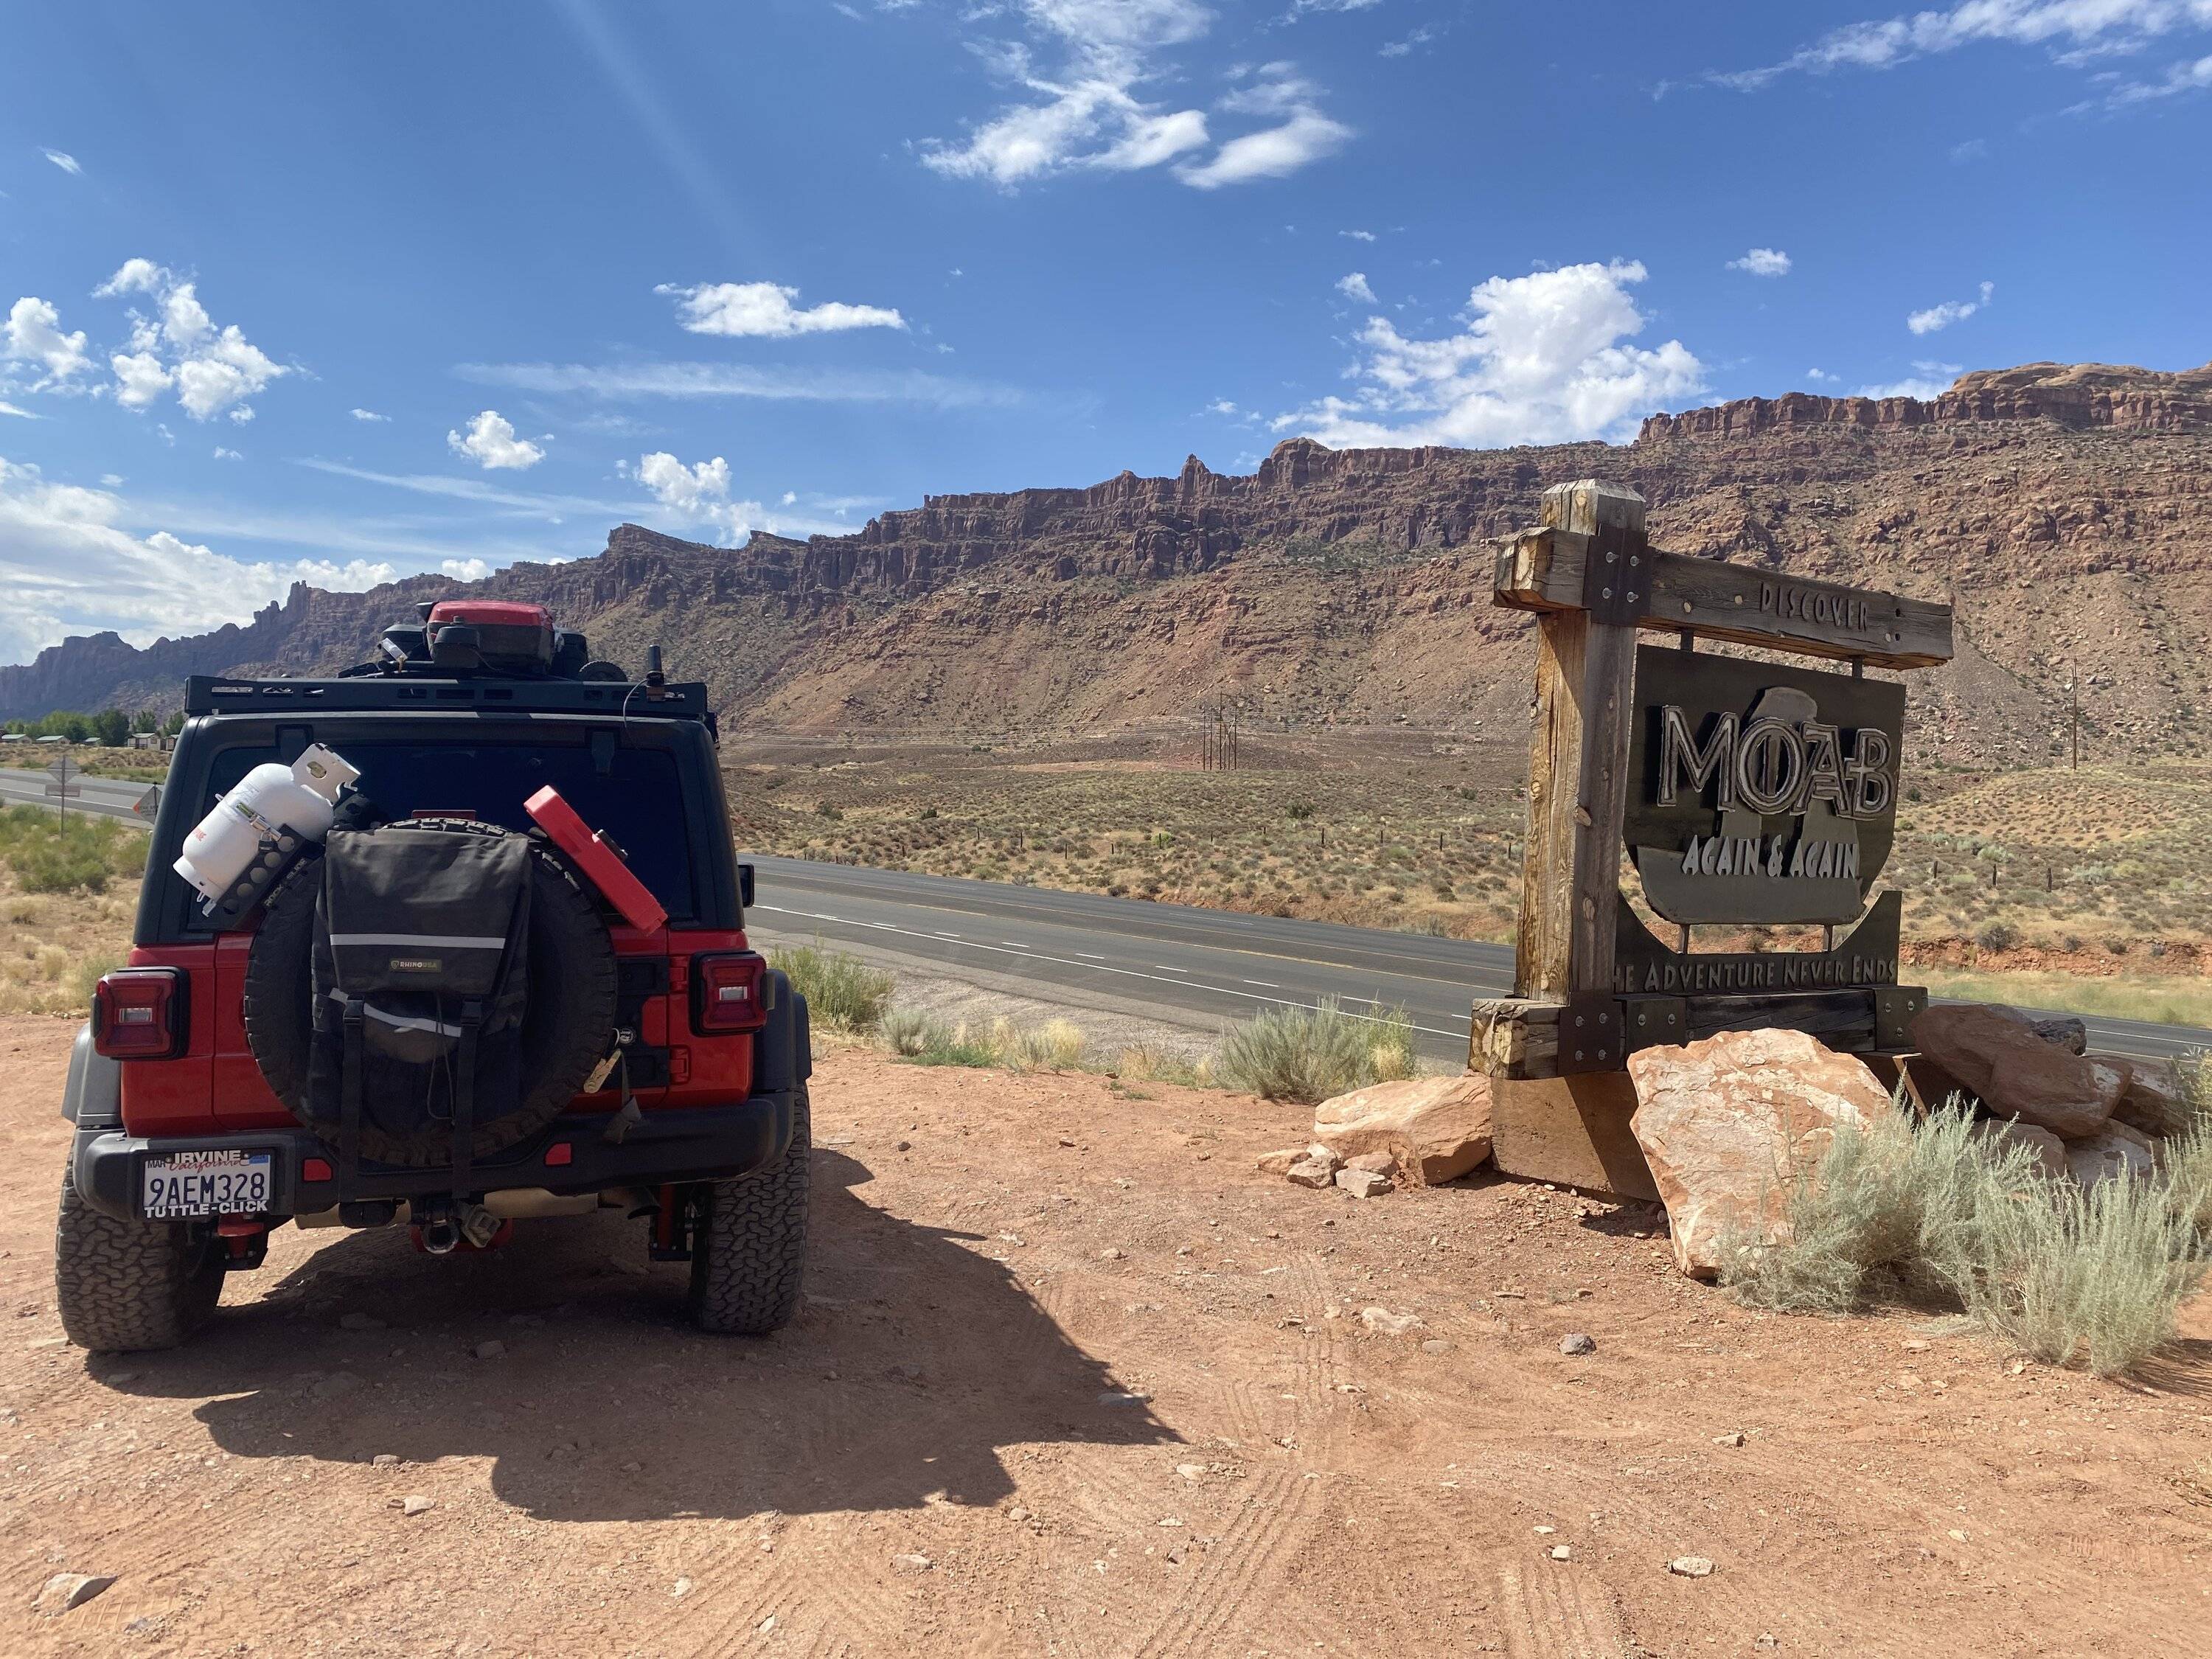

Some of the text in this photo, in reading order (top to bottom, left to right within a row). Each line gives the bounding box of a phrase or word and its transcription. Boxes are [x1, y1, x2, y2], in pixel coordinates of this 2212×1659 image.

[1759, 582, 1868, 632] DISCOVER
[1657, 704, 1891, 821] MOAB
[1681, 834, 1859, 879] AGAIN & AGAIN
[1612, 954, 1896, 993] HE ADVENTURE NEVER ENDS
[174, 1150, 242, 1164] IRVINE
[144, 1200, 268, 1218] TUTTLE-CLICK
[149, 1172, 265, 1207] 9AEM328
